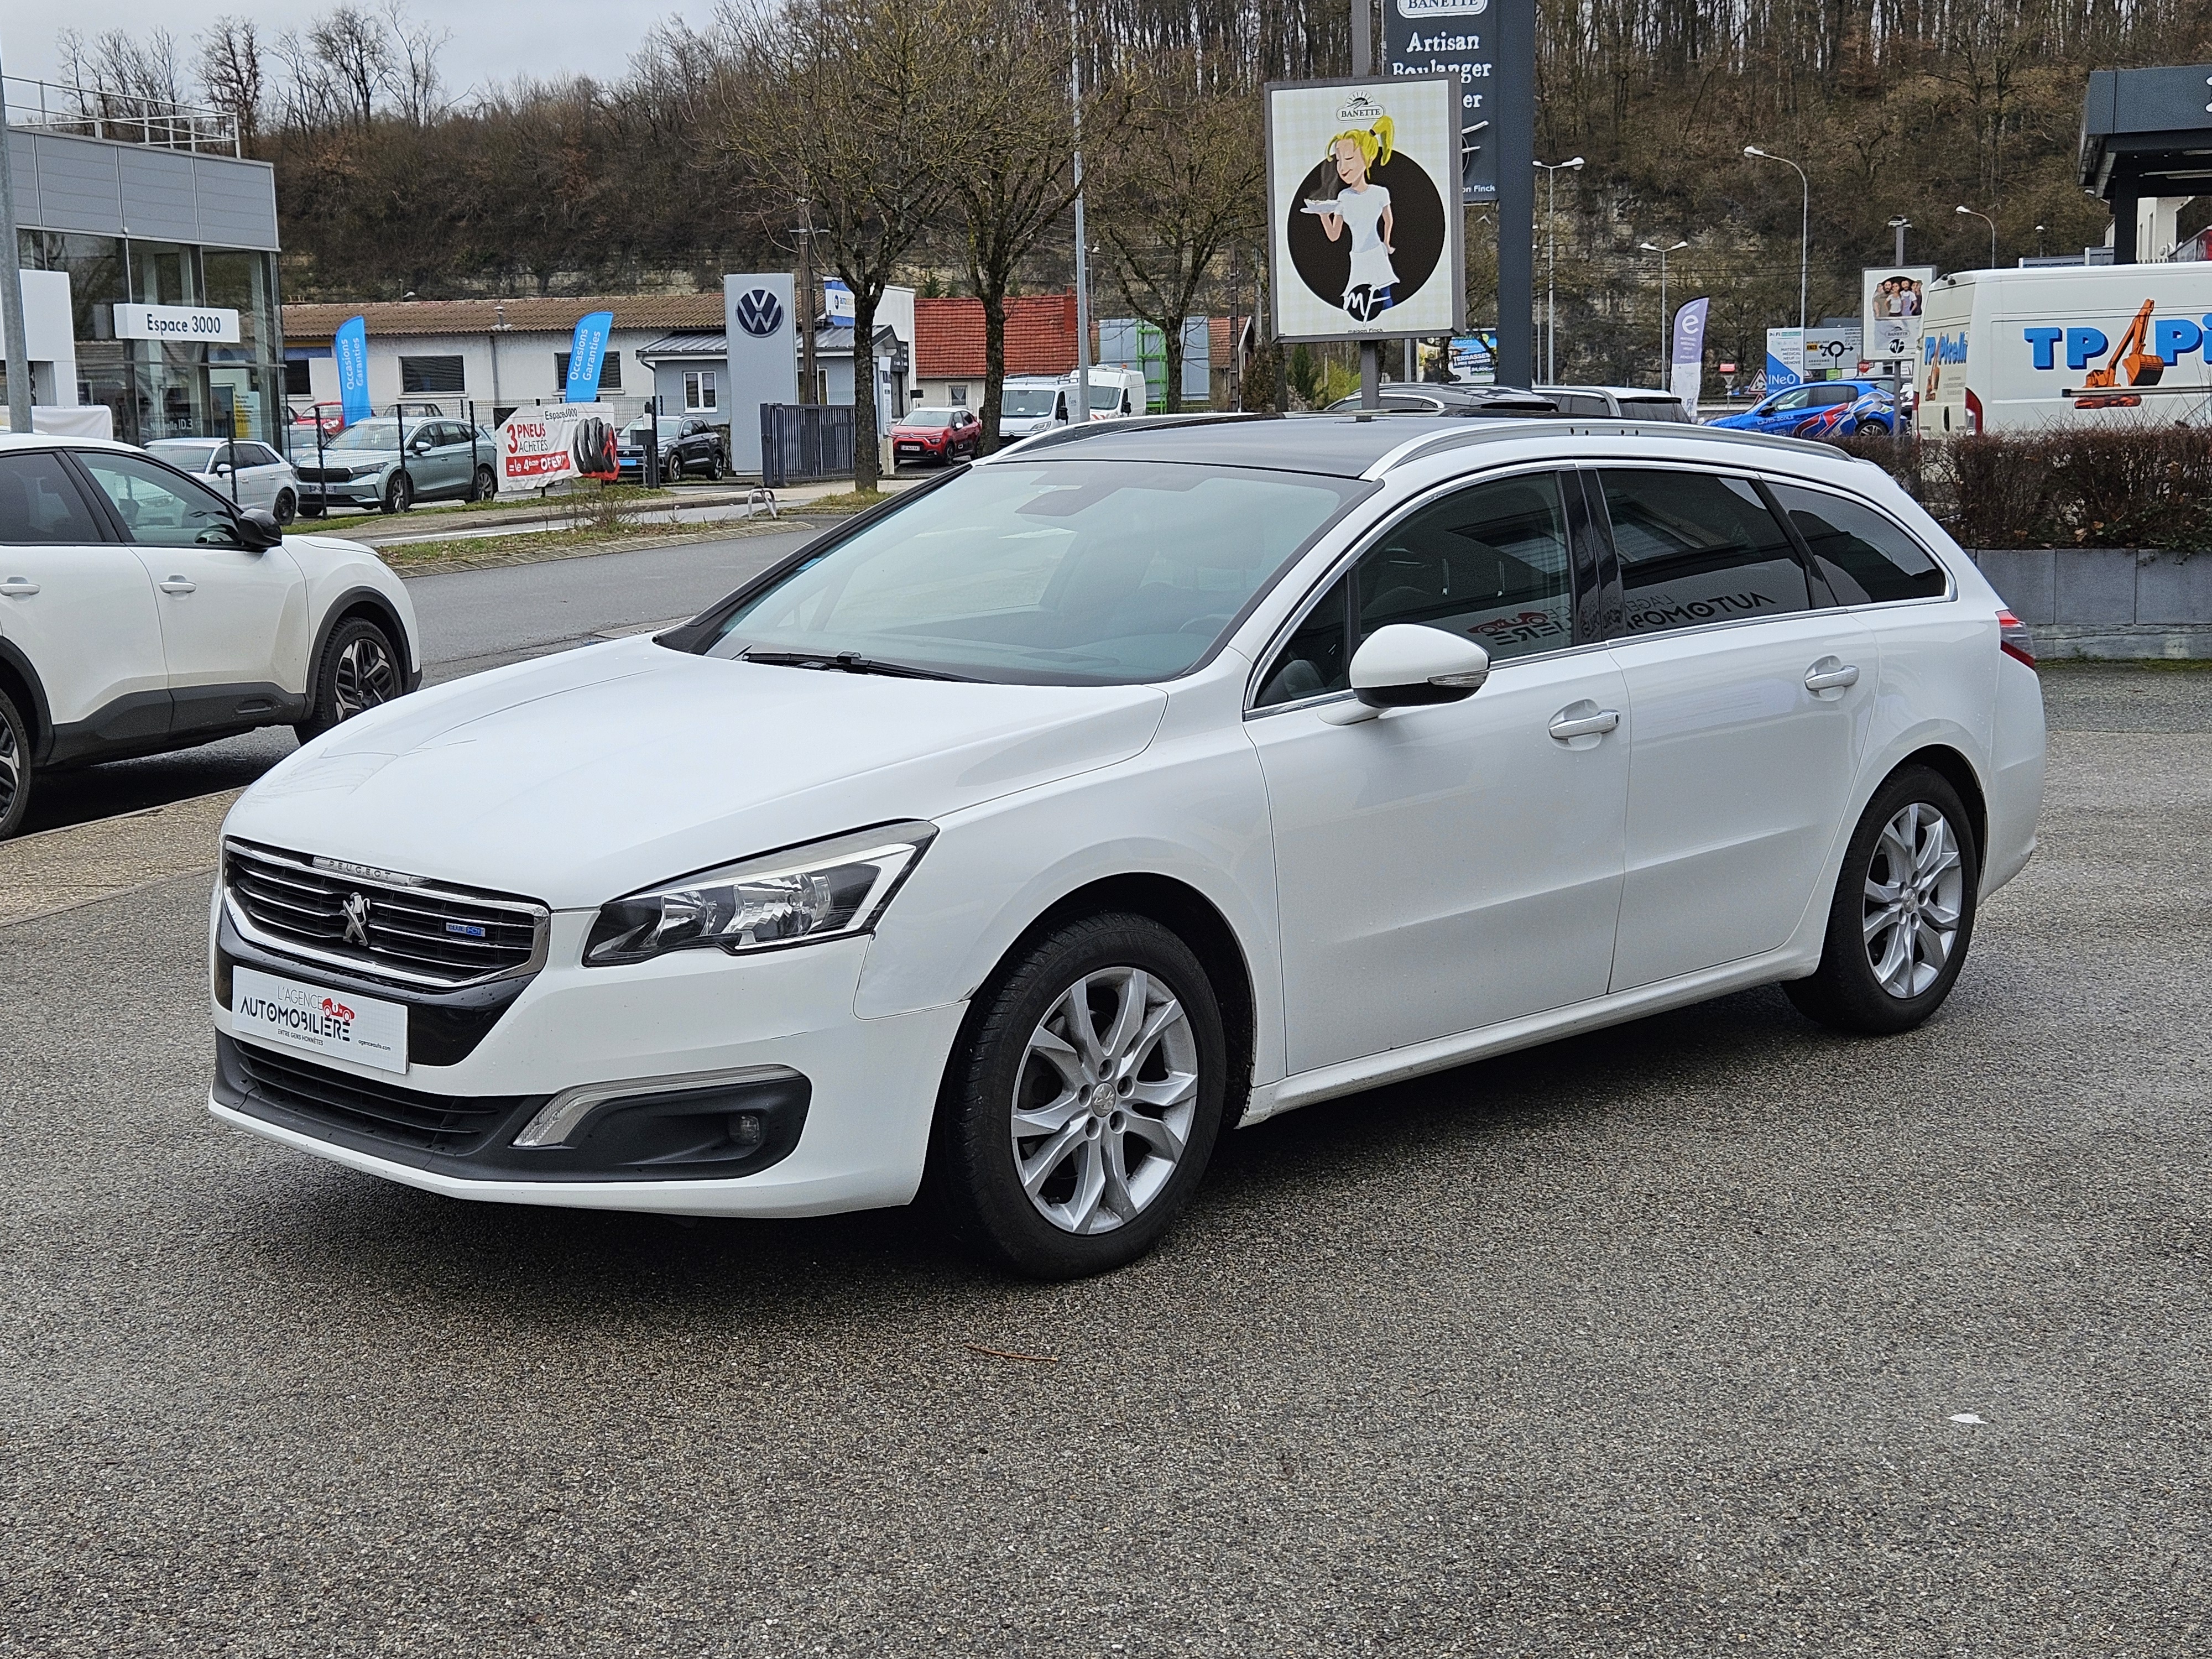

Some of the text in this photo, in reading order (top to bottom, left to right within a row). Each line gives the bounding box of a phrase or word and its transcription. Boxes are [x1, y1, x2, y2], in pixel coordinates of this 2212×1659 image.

[1406, 31, 1480, 53] Artisan
[1341, 108, 1381, 118] BANETTE
[1473, 184, 1496, 192] Finck
[147, 313, 221, 336] Espace 3000
[1924, 336, 1936, 366] TP
[2023, 313, 2212, 370] TP Pi
[341, 338, 354, 390] Occasions
[352, 337, 364, 387] Garanties
[569, 328, 588, 380] Occasions
[582, 331, 601, 381] Garanties
[1453, 352, 1491, 362] TERRASSES
[506, 424, 518, 455] 3
[517, 422, 546, 439] PNEUS
[518, 437, 549, 453] ACHETÉS
[329, 860, 391, 879] PEUGEOT
[277, 985, 324, 1011] L'AGENCE
[277, 1029, 290, 1038] ENTRE
[290, 1031, 301, 1041] GENS
[358, 1039, 391, 1051] agenceauto.com
